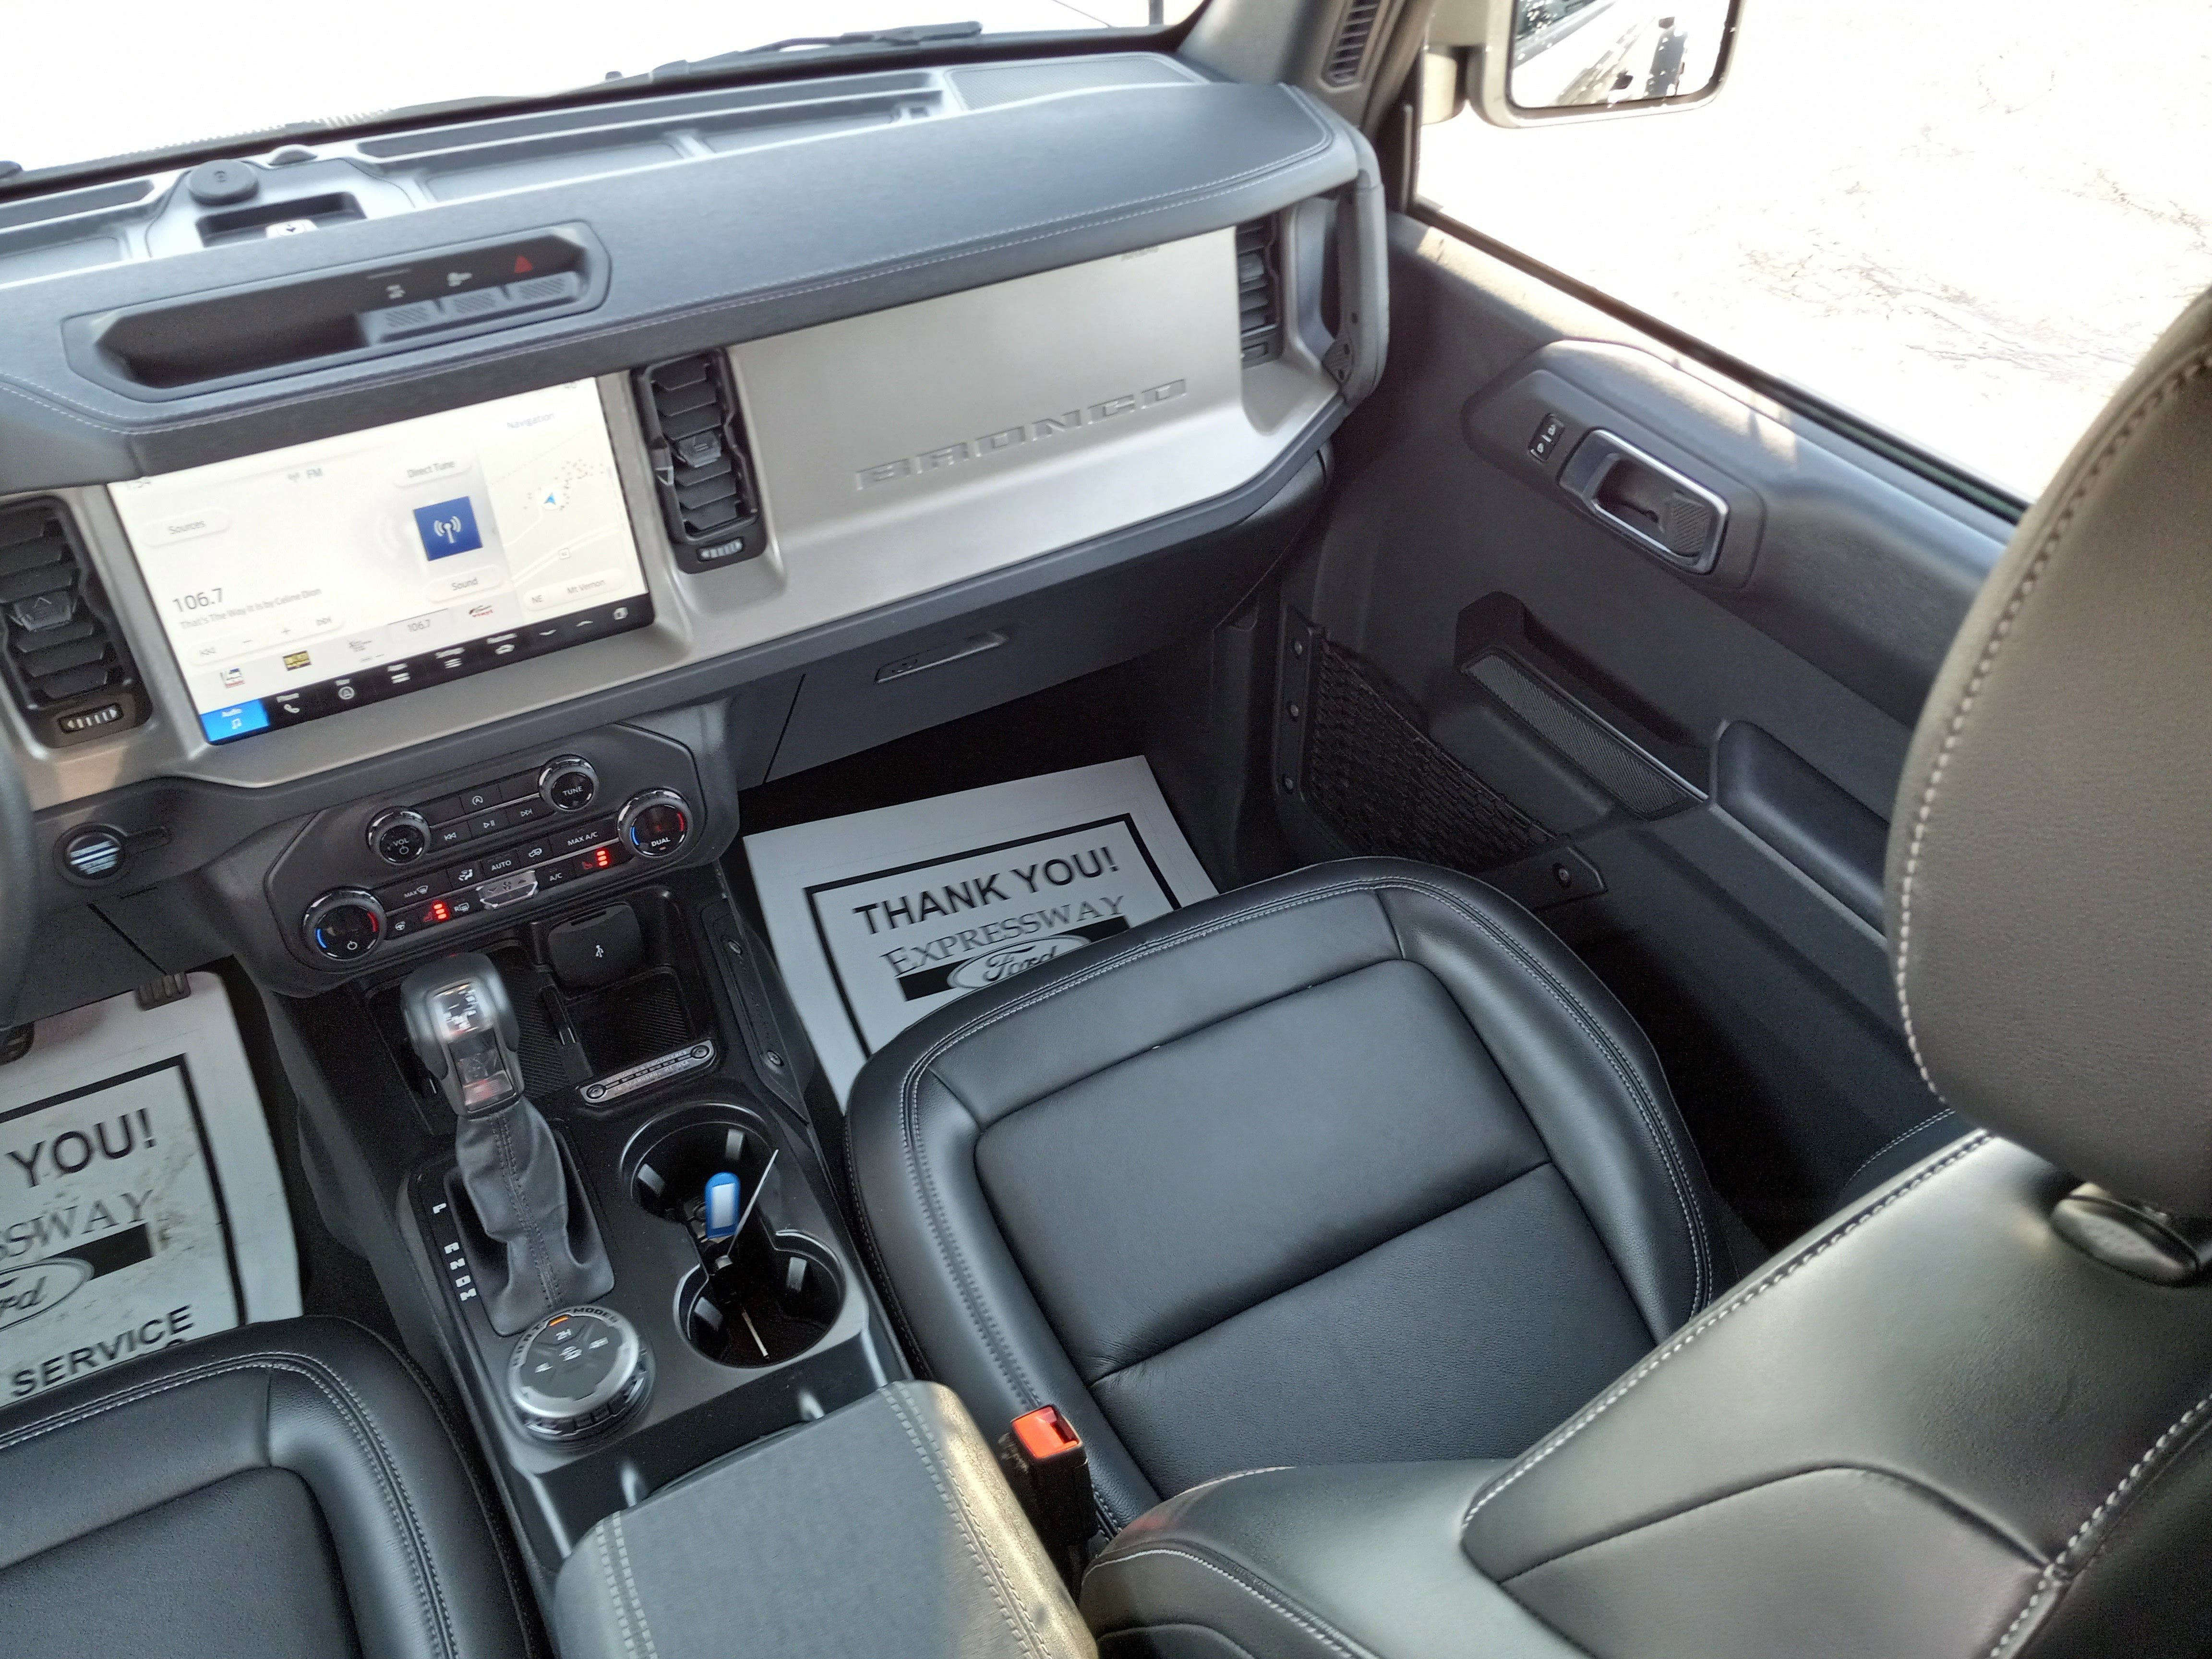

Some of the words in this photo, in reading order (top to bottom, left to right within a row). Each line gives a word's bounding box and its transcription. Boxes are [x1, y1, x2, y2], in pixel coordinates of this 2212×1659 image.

[507, 413, 555, 430] Navigation
[854, 378, 1187, 491] BRONCO
[306, 467, 323, 479] FM
[407, 466, 430, 479] Direct
[432, 459, 456, 473] Tune
[167, 519, 206, 535] Sources
[451, 577, 479, 591] Sound
[579, 578, 606, 592] Vernon
[172, 587, 224, 613] 106.7
[531, 594, 544, 605] NE
[408, 618, 431, 633] 106.7
[562, 785, 584, 797] TUNE
[393, 838, 409, 847] VOL
[567, 835, 585, 846] MAX
[585, 830, 599, 841] A/C
[650, 836, 671, 848] DUAL
[491, 859, 512, 872] AUTO
[549, 872, 563, 882] A/C
[404, 890, 418, 899] MAX
[853, 872, 1010, 936] THANK
[1010, 845, 1119, 895] YOU!
[880, 895, 1125, 978] EXPRESSWAY
[982, 945, 1058, 982] Ford
[7, 1107, 157, 1189] YOU!
[433, 1202, 447, 1214] P
[444, 1241, 460, 1254] R
[450, 1257, 466, 1271] N
[456, 1274, 471, 1288] D
[459, 1287, 477, 1301] M
[555, 1328, 572, 1341] 2H
[11, 1304, 194, 1397] SERVICE
